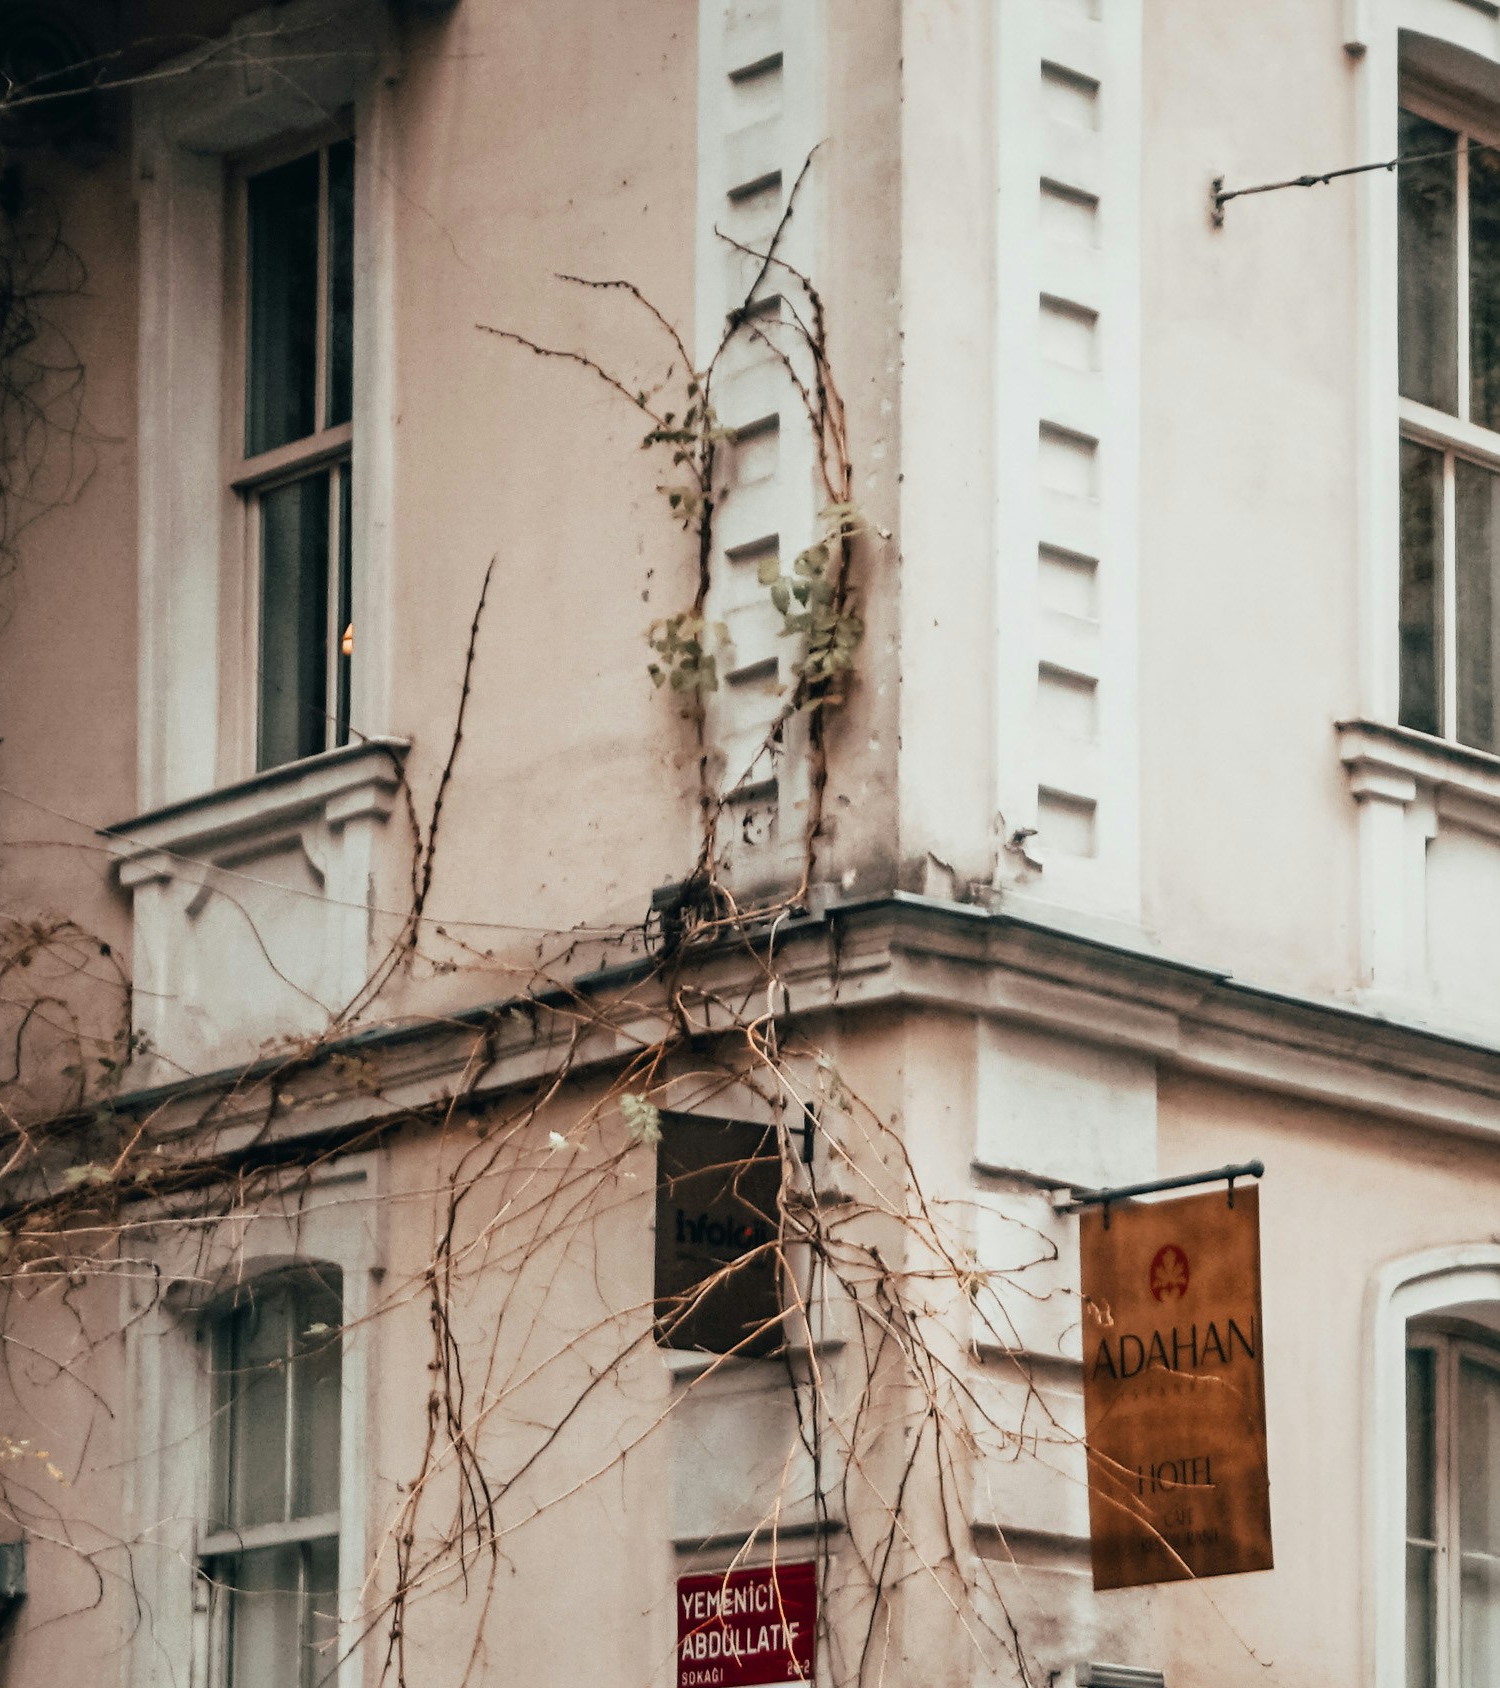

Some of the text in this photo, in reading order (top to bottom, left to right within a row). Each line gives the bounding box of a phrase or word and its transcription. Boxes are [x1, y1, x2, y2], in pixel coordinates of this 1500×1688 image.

[1092, 1315, 1255, 1380] ADAHAN
[1138, 1456, 1214, 1495] HOTEL
[681, 1667, 724, 1686] SOKAĞI
